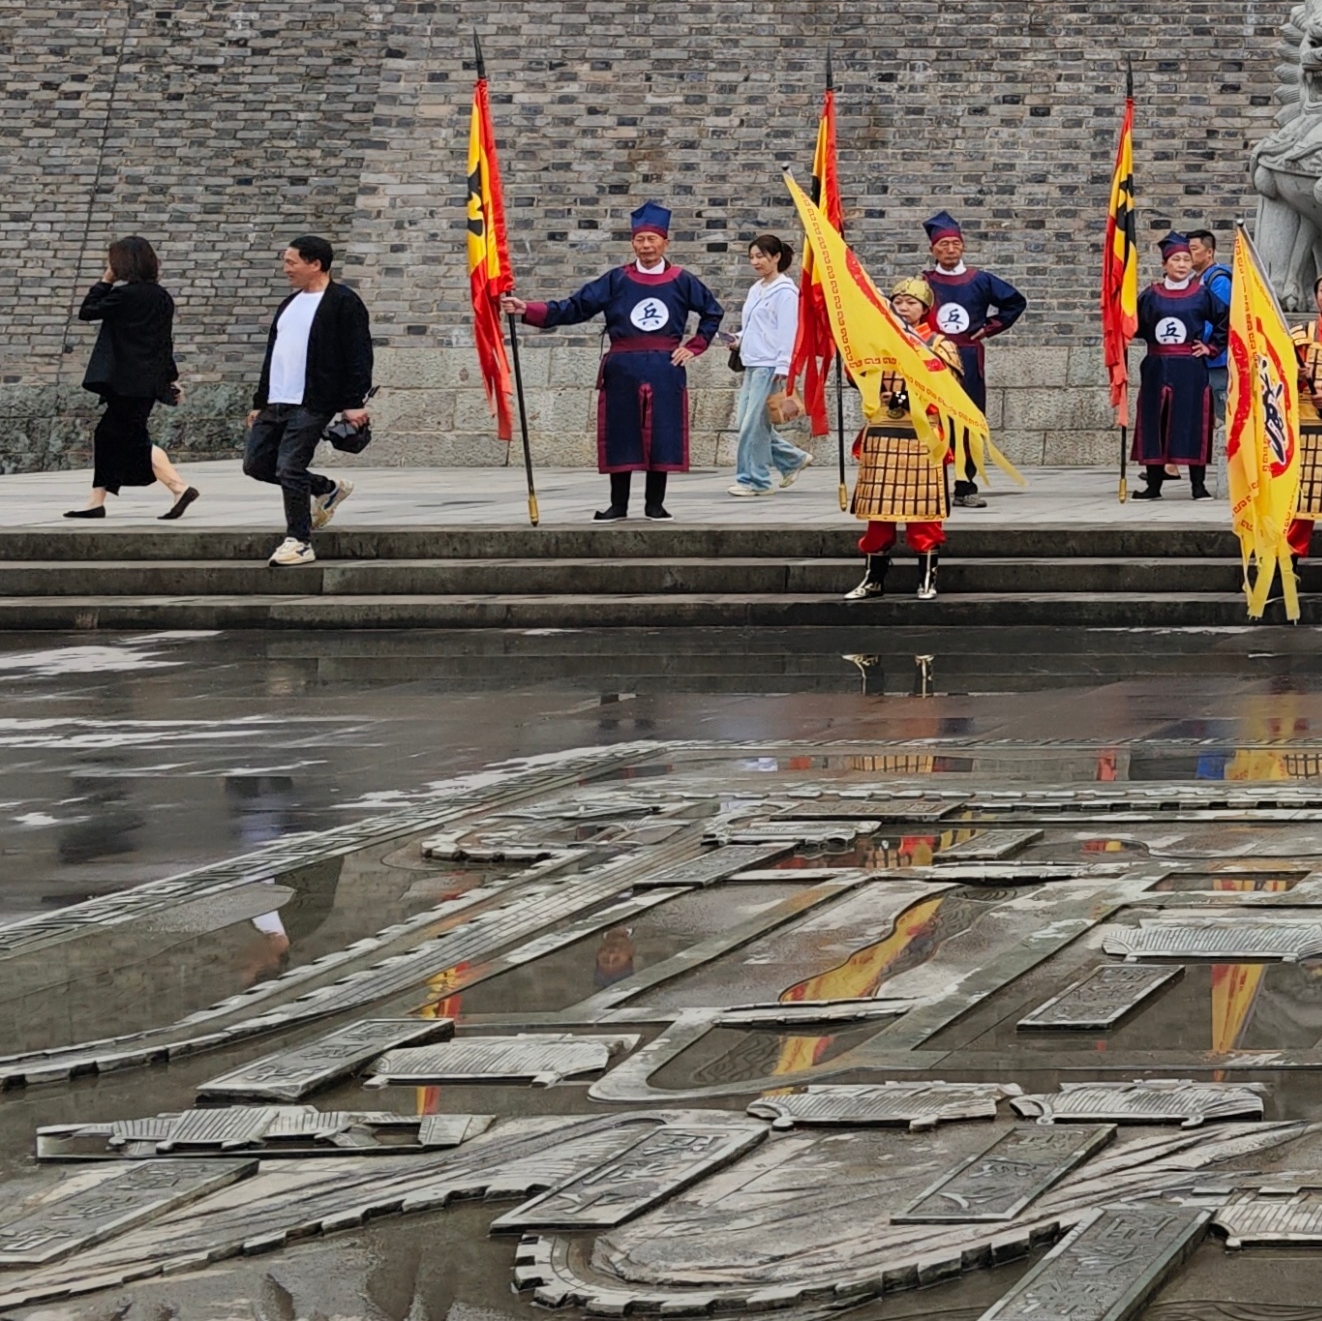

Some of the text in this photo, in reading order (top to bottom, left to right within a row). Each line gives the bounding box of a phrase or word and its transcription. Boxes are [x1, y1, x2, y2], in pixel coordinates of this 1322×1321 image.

[638, 302, 664, 327] 兵
[941, 308, 965, 331] 兵
[1160, 321, 1182, 343] 兵
